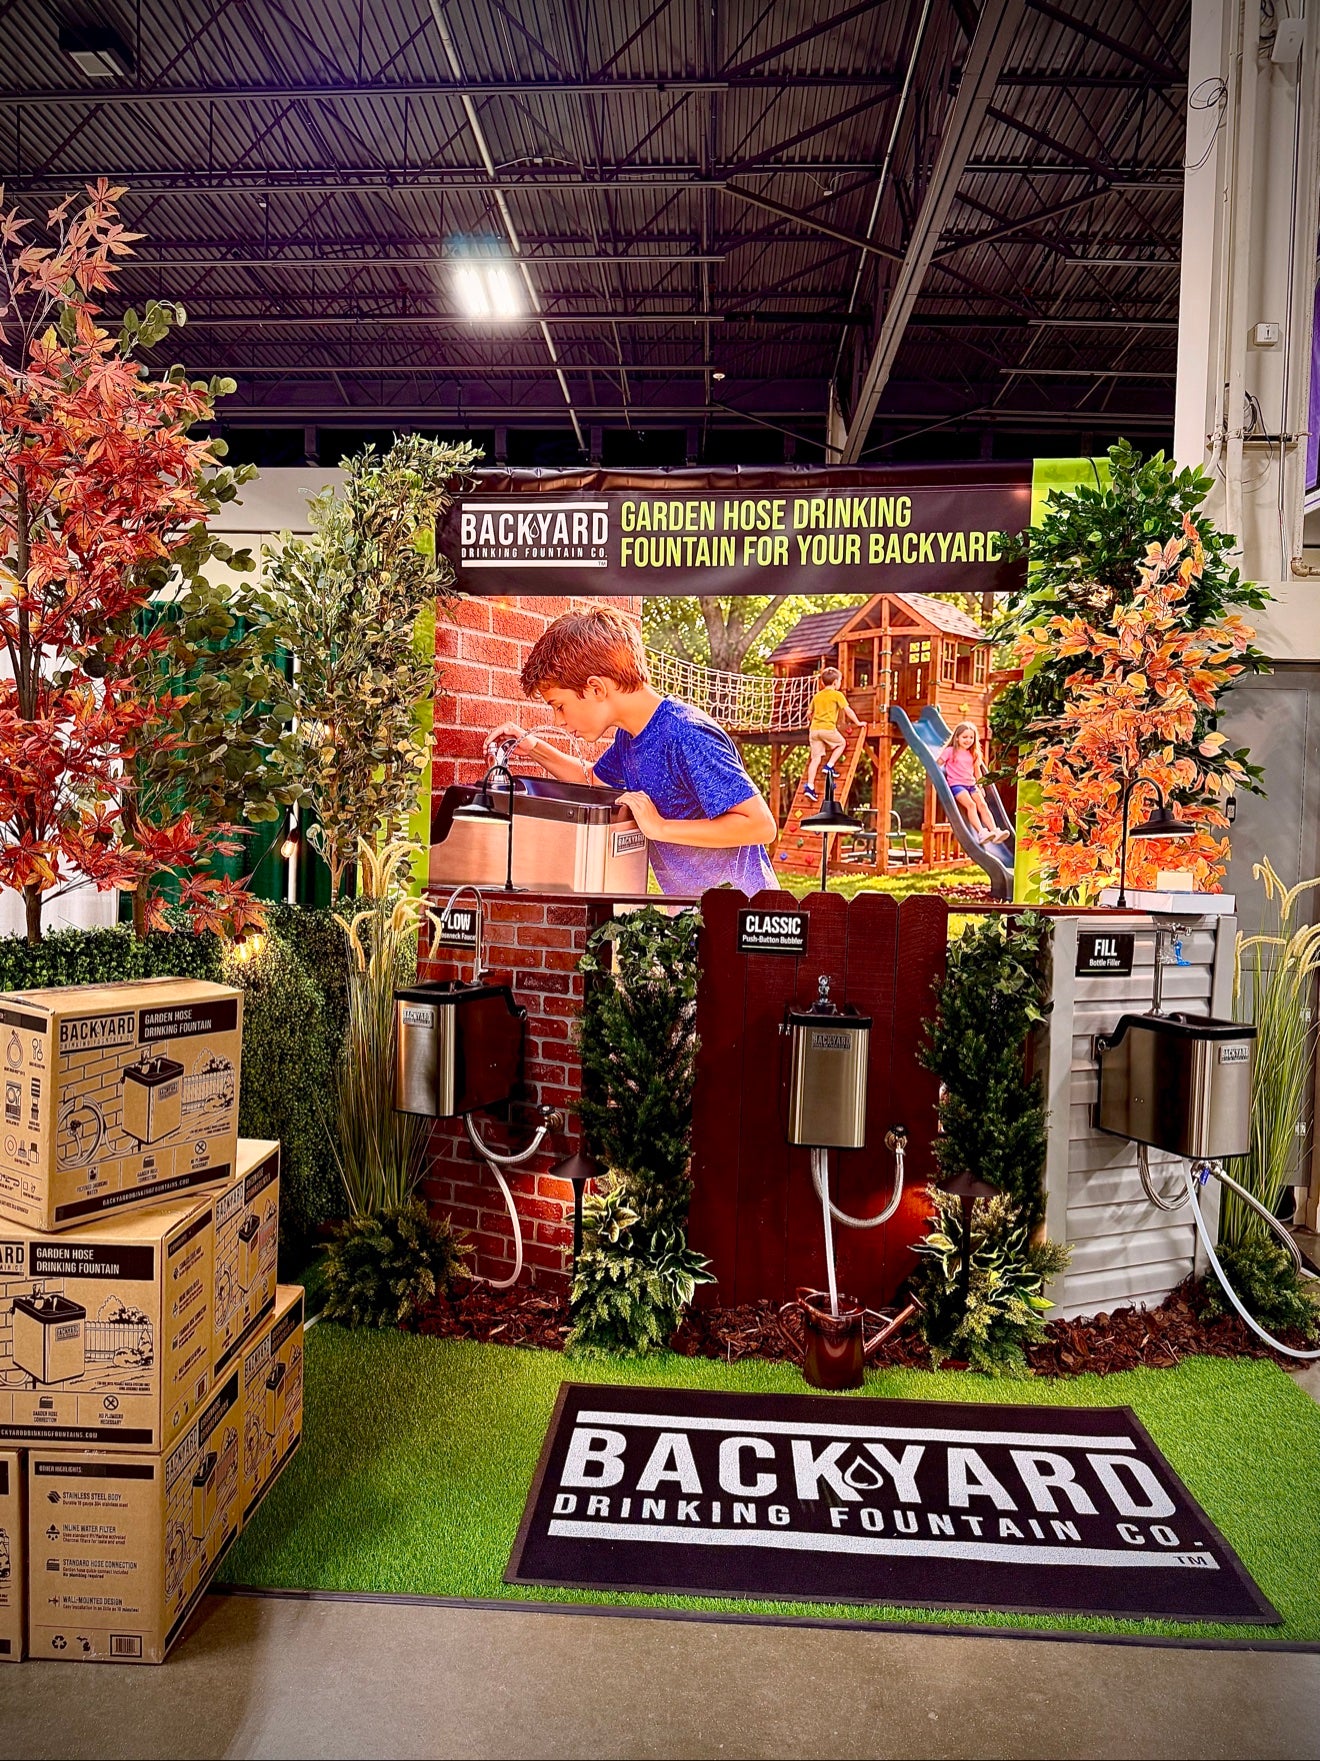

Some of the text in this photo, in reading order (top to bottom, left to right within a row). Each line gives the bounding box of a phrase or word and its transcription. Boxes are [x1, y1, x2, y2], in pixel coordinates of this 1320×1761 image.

[621, 496, 912, 532] GARDEN HOSE DRINKING
[461, 512, 609, 545] BACKYARD
[461, 548, 608, 558] DRINKING FOUNTAIN CO.
[620, 531, 1002, 567] FOUNTAIN FOR YOUR BACKYARD
[745, 915, 801, 935] CLASSIC
[742, 934, 803, 945] Push-Button Bubbler
[1094, 939, 1118, 957] FILL
[1089, 958, 1120, 967] Bottle Filler
[144, 1009, 192, 1025] GARDEN HOSE
[60, 1016, 135, 1043] BACKYARD
[144, 1019, 212, 1038] DRINKING FOUNTAIN
[36, 1247, 94, 1260] GARDEN HOSE
[36, 1260, 120, 1275] DRINKING FOUNTAIN
[560, 1427, 1176, 1518] BACKYARD
[63, 1492, 121, 1501] STAINLESS STEEL BODY
[553, 1493, 1204, 1546] DRINKING FOUNTAIN CO.
[63, 1559, 138, 1569] STANDARD HOSE CONNECTION
[1177, 1555, 1207, 1566] TM
[63, 1596, 123, 1606] WALL-MOUNTED DESIGN
